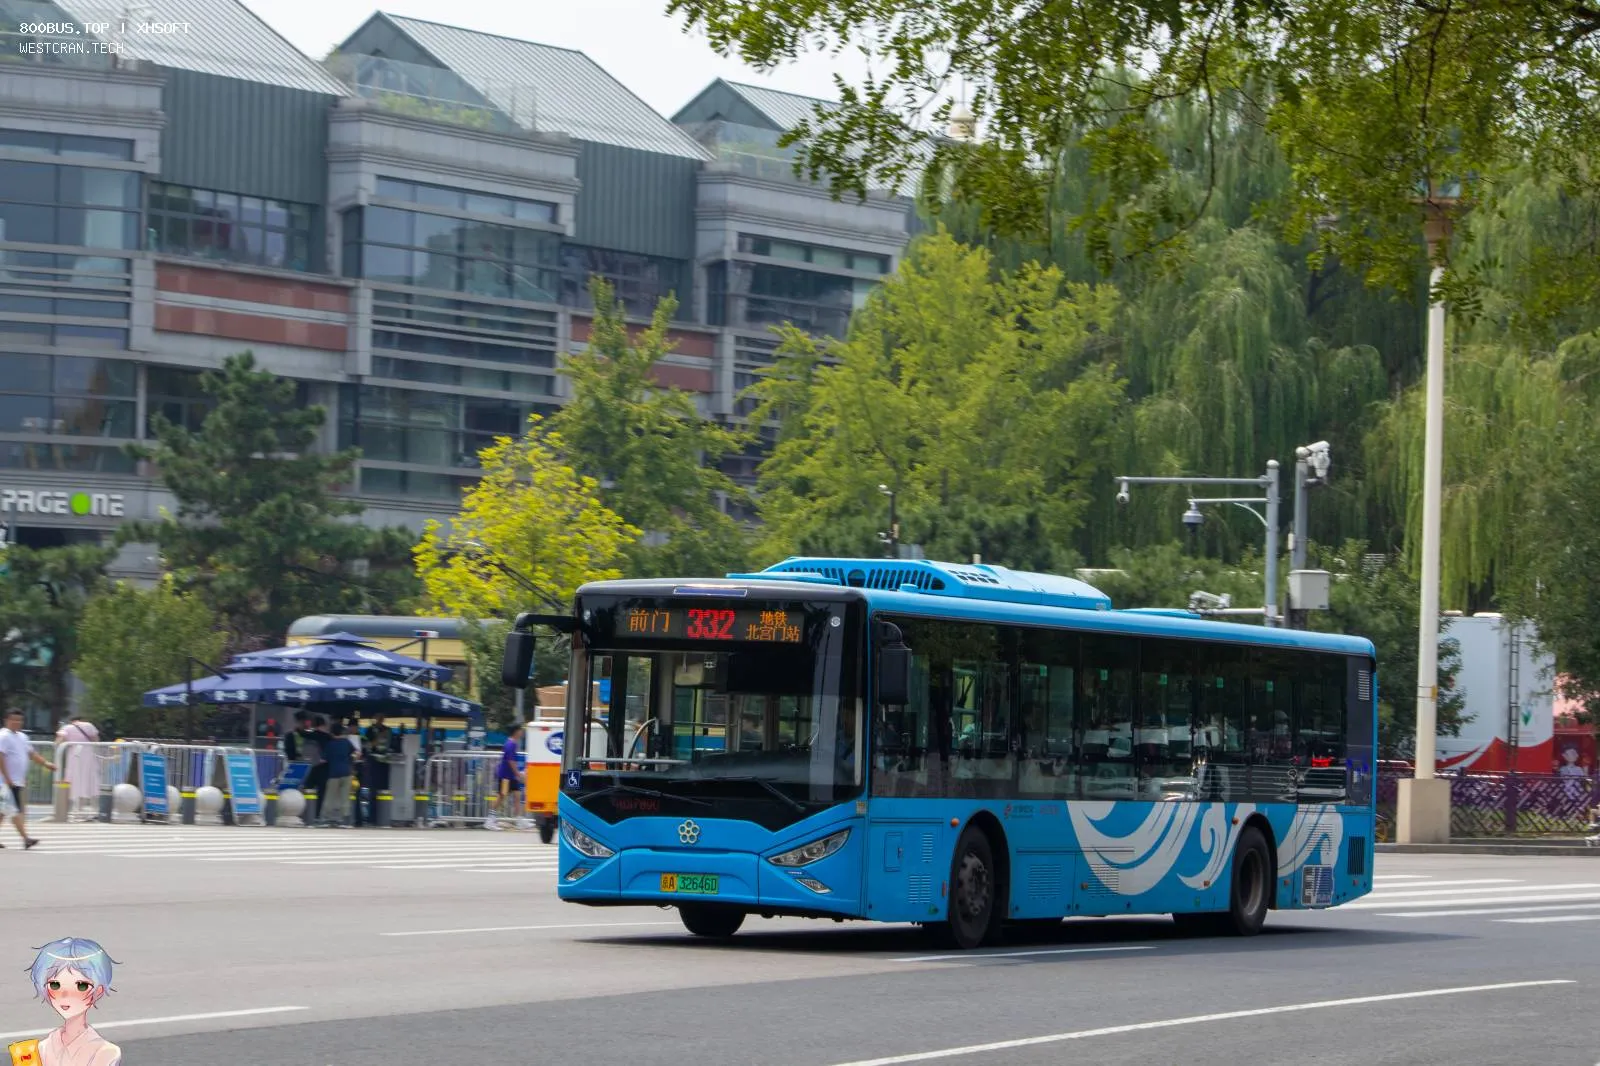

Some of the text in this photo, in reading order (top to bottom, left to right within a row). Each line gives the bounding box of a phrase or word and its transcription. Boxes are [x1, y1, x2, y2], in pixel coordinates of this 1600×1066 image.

[1, 489, 68, 513] PAGE
[630, 609, 671, 633] 前门
[687, 609, 735, 639] 332
[760, 611, 788, 626] 地铁
[745, 624, 800, 642] 北宫门站
